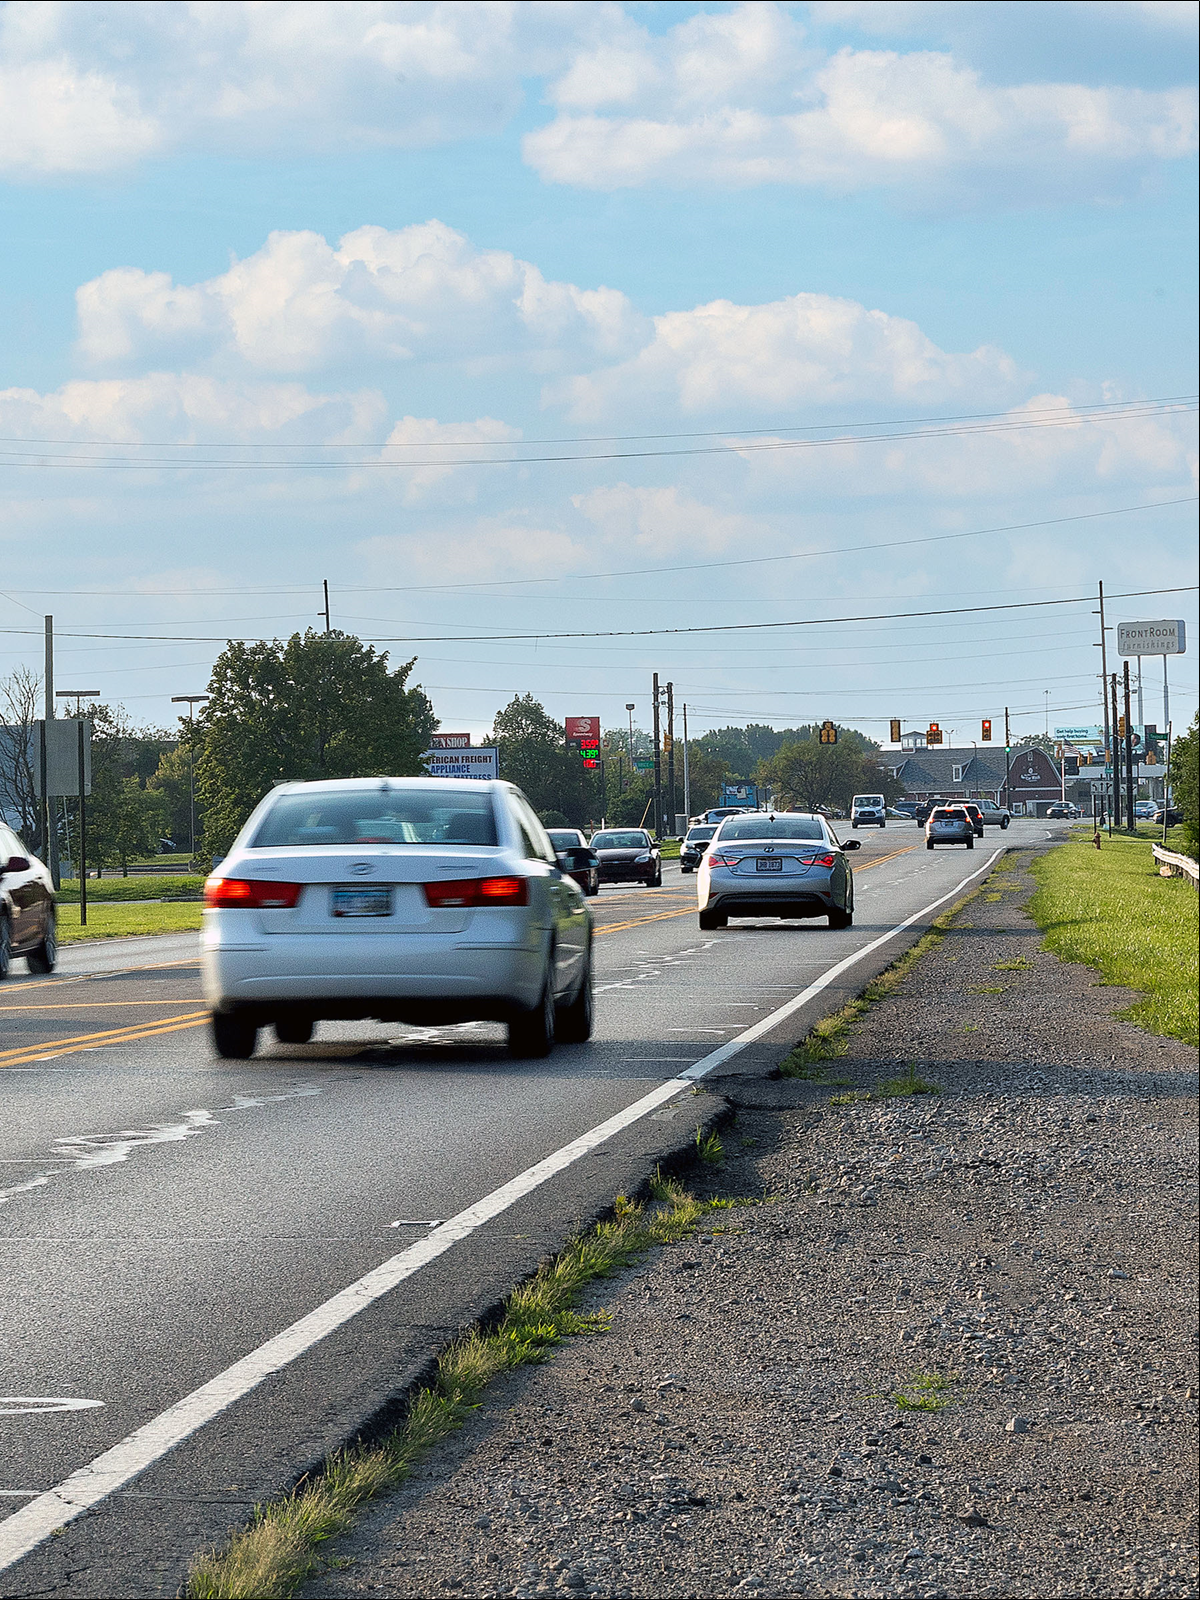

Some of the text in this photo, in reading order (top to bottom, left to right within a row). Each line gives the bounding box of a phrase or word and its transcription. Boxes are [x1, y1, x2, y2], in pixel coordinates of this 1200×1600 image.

[1122, 640, 1175, 652] furnishings
[447, 736, 468, 747] SHOP
[430, 755, 493, 764] ERICAN FREIGHT
[431, 764, 471, 774] APPLIANCE
